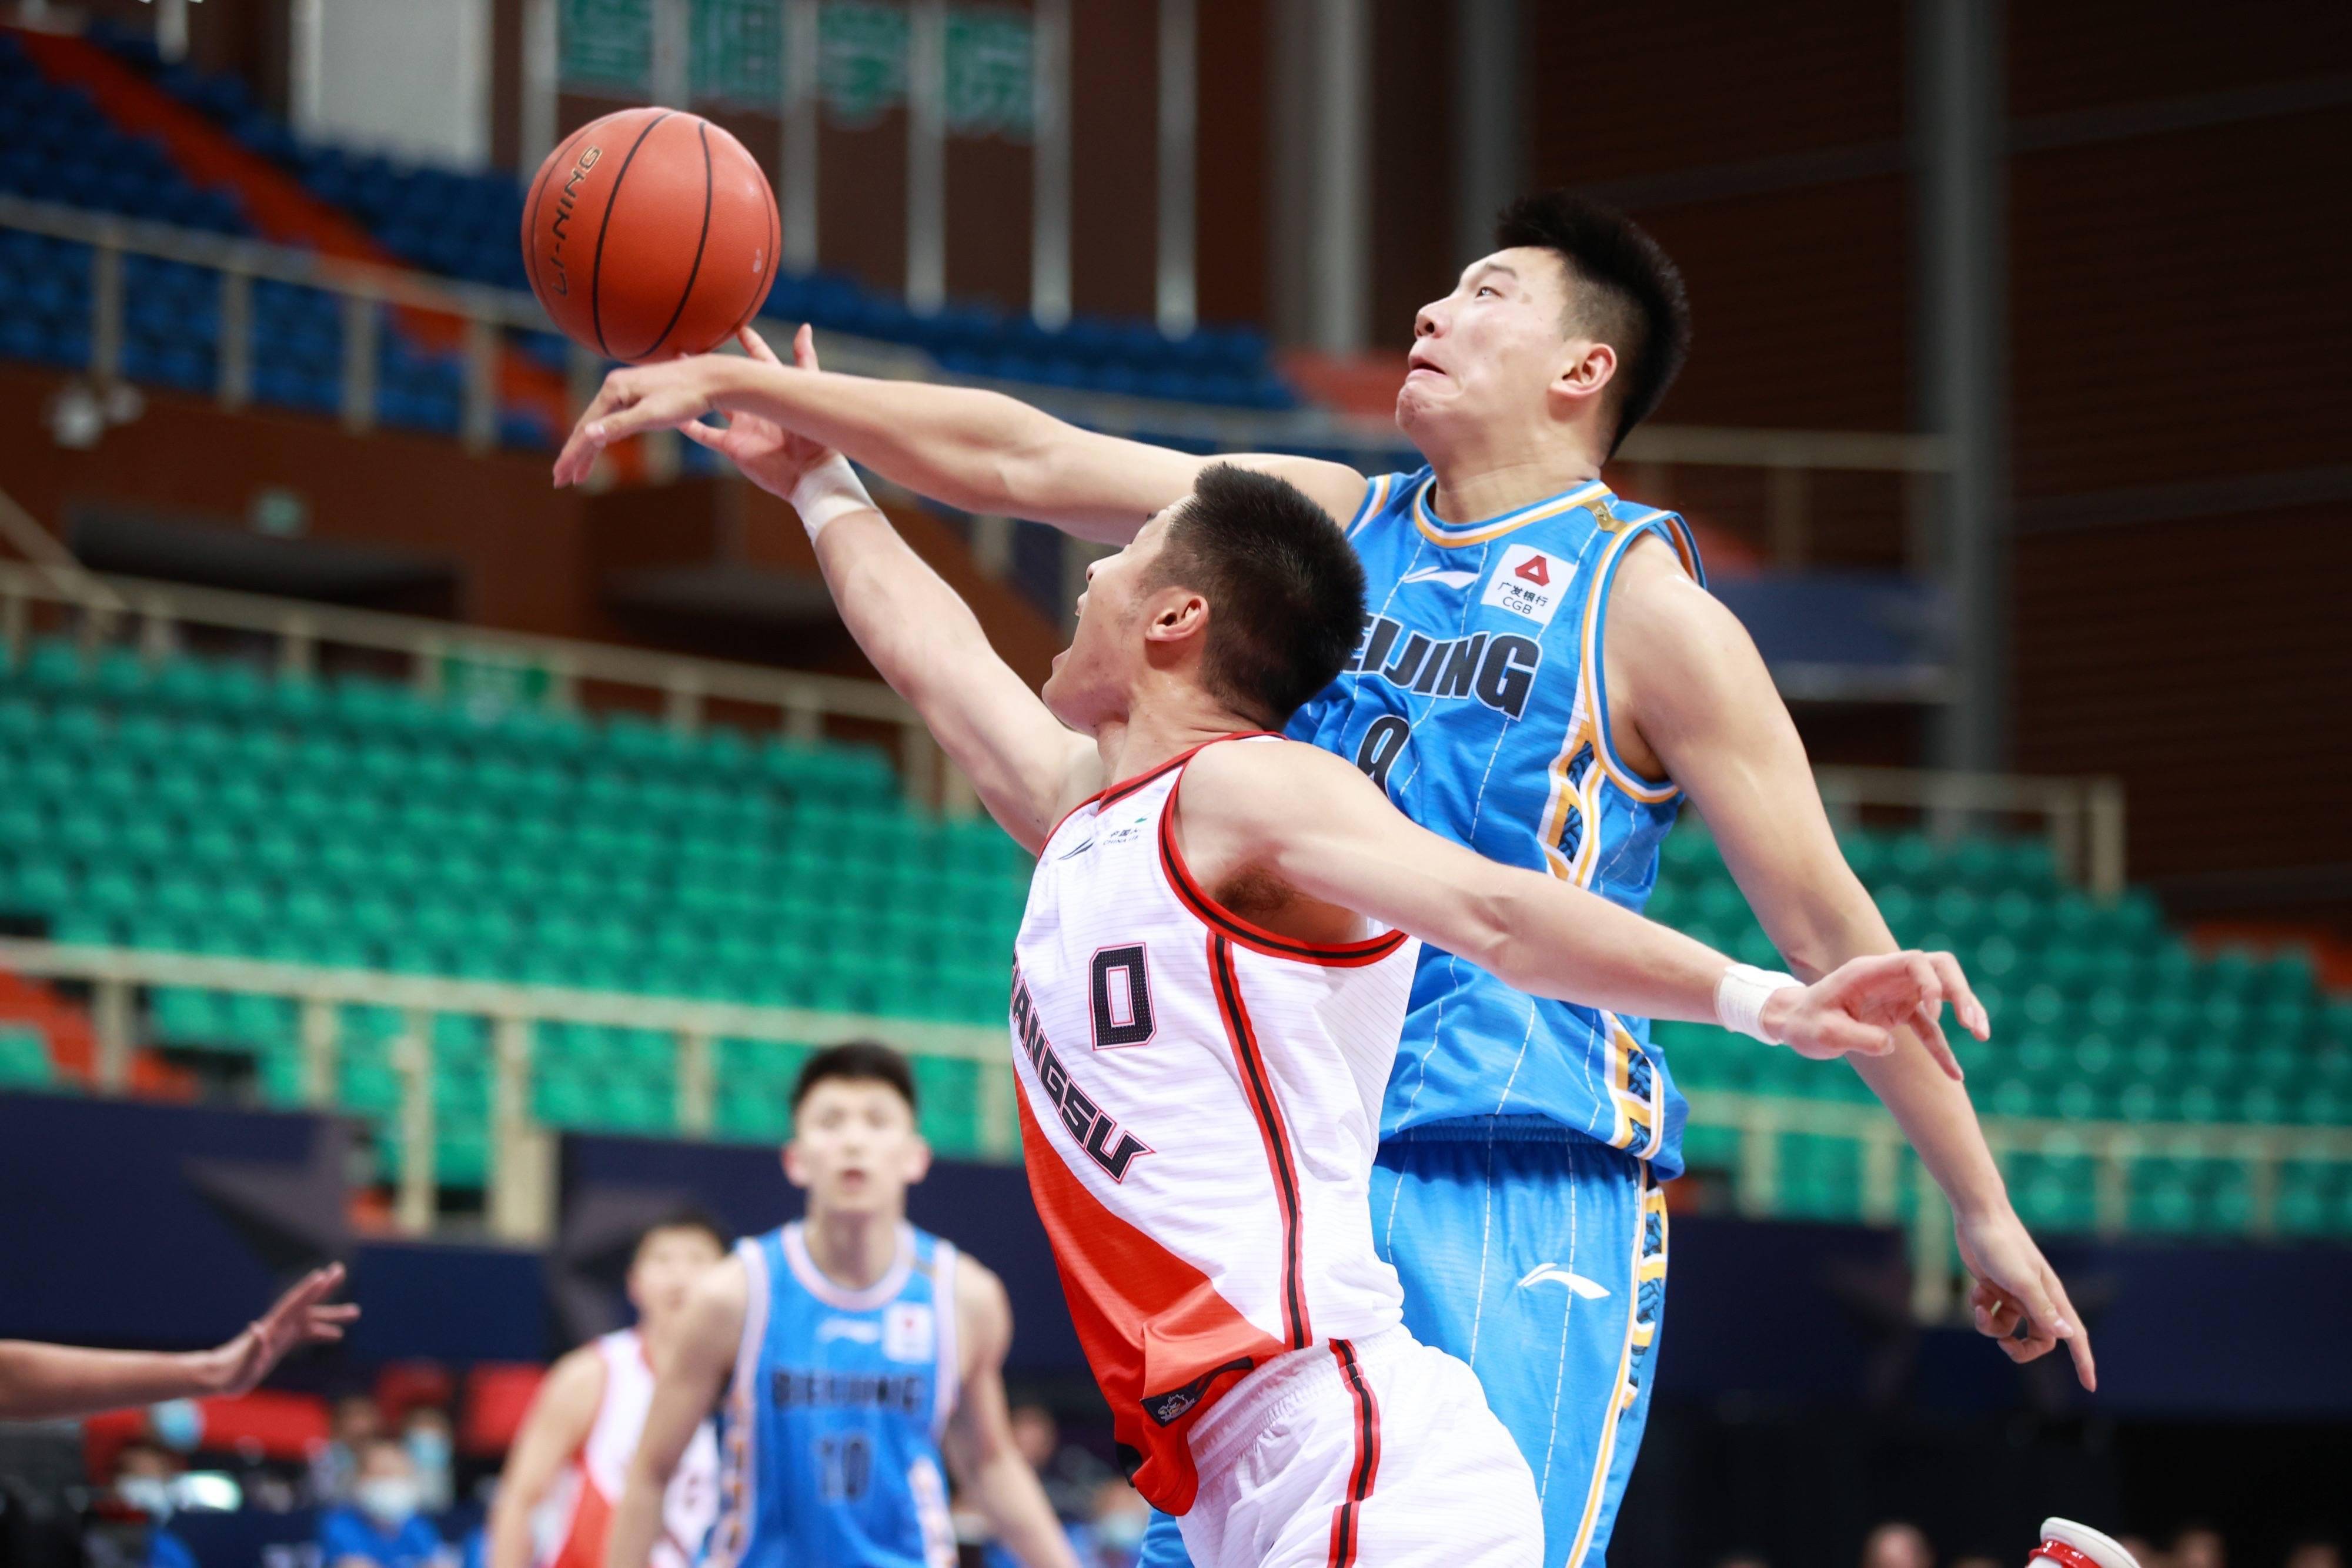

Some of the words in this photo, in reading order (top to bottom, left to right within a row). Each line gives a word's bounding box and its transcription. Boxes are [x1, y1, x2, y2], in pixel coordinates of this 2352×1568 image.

[550, 145, 603, 297] LI-NING
[1497, 581, 1549, 607] 广发银行
[1502, 596, 1533, 614] CGB
[1341, 612, 1543, 722] EIJING
[1089, 942, 1157, 1051] 0
[1011, 947, 1157, 1184] ANGSU
